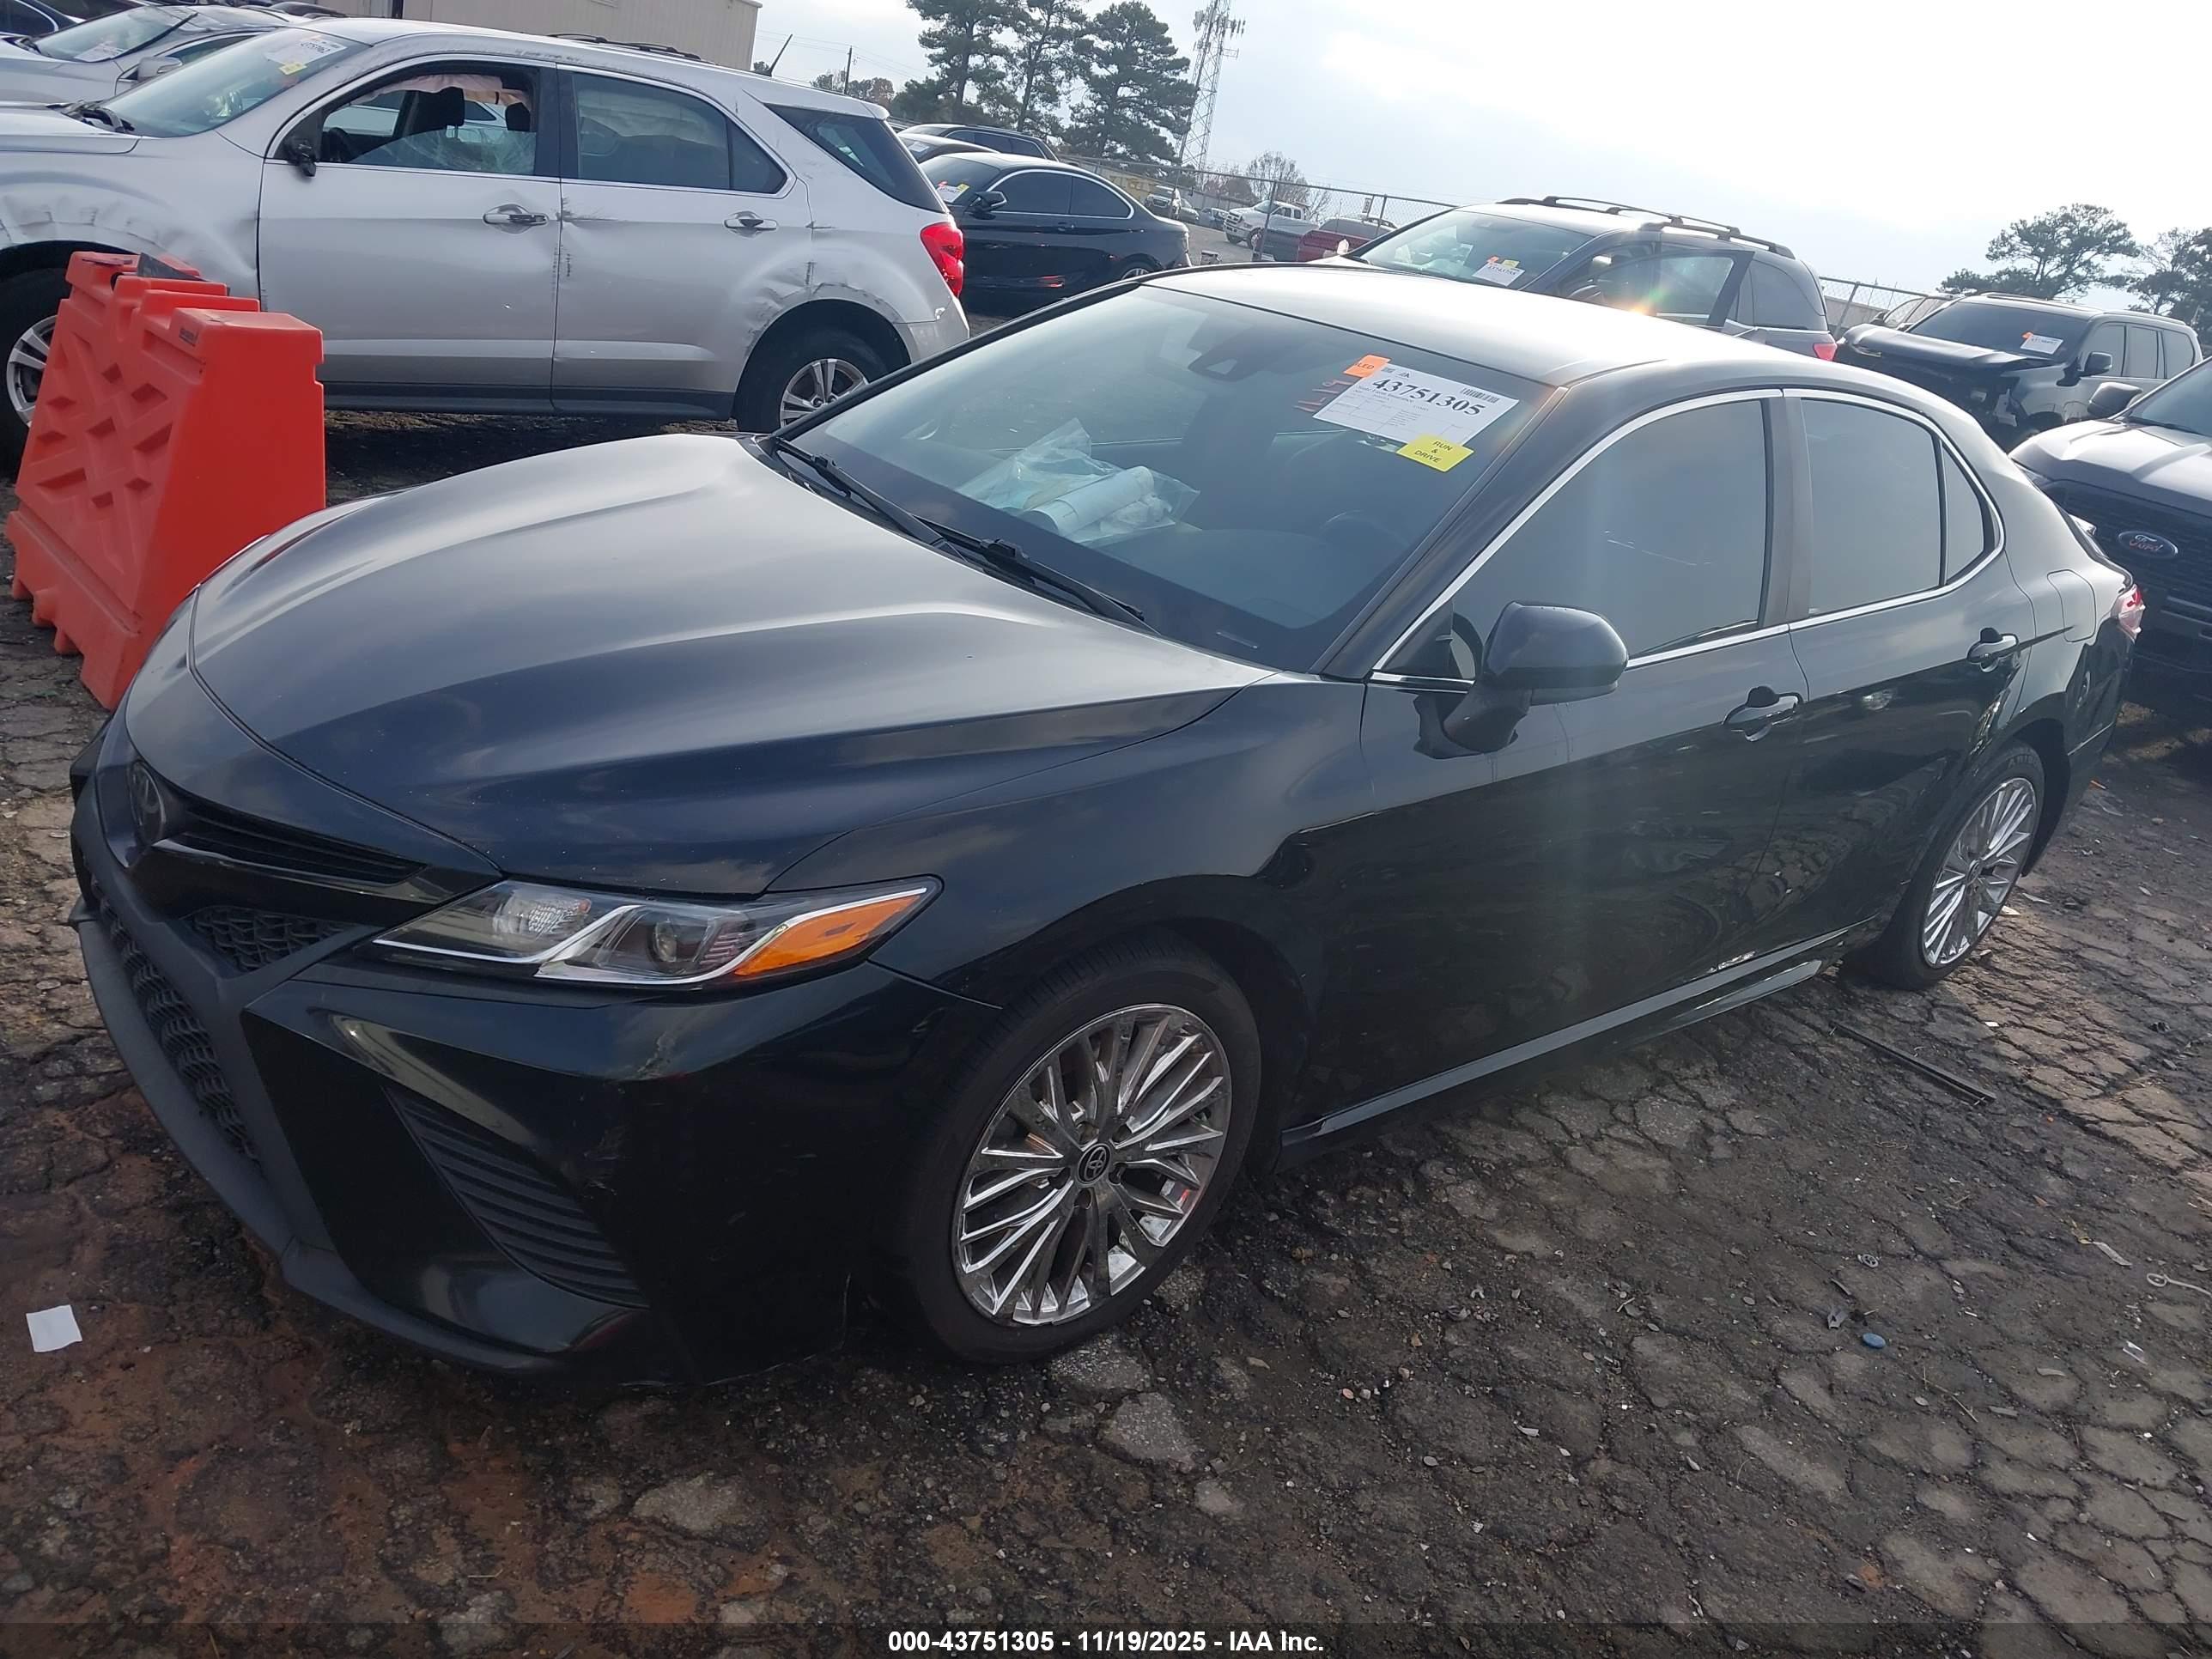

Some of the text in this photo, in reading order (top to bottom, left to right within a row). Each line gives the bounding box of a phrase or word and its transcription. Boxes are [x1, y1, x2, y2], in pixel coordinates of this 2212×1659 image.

[1372, 379, 1486, 416] 43751305
[1431, 441, 1453, 452] RUN
[1414, 449, 1443, 464] DRIVE
